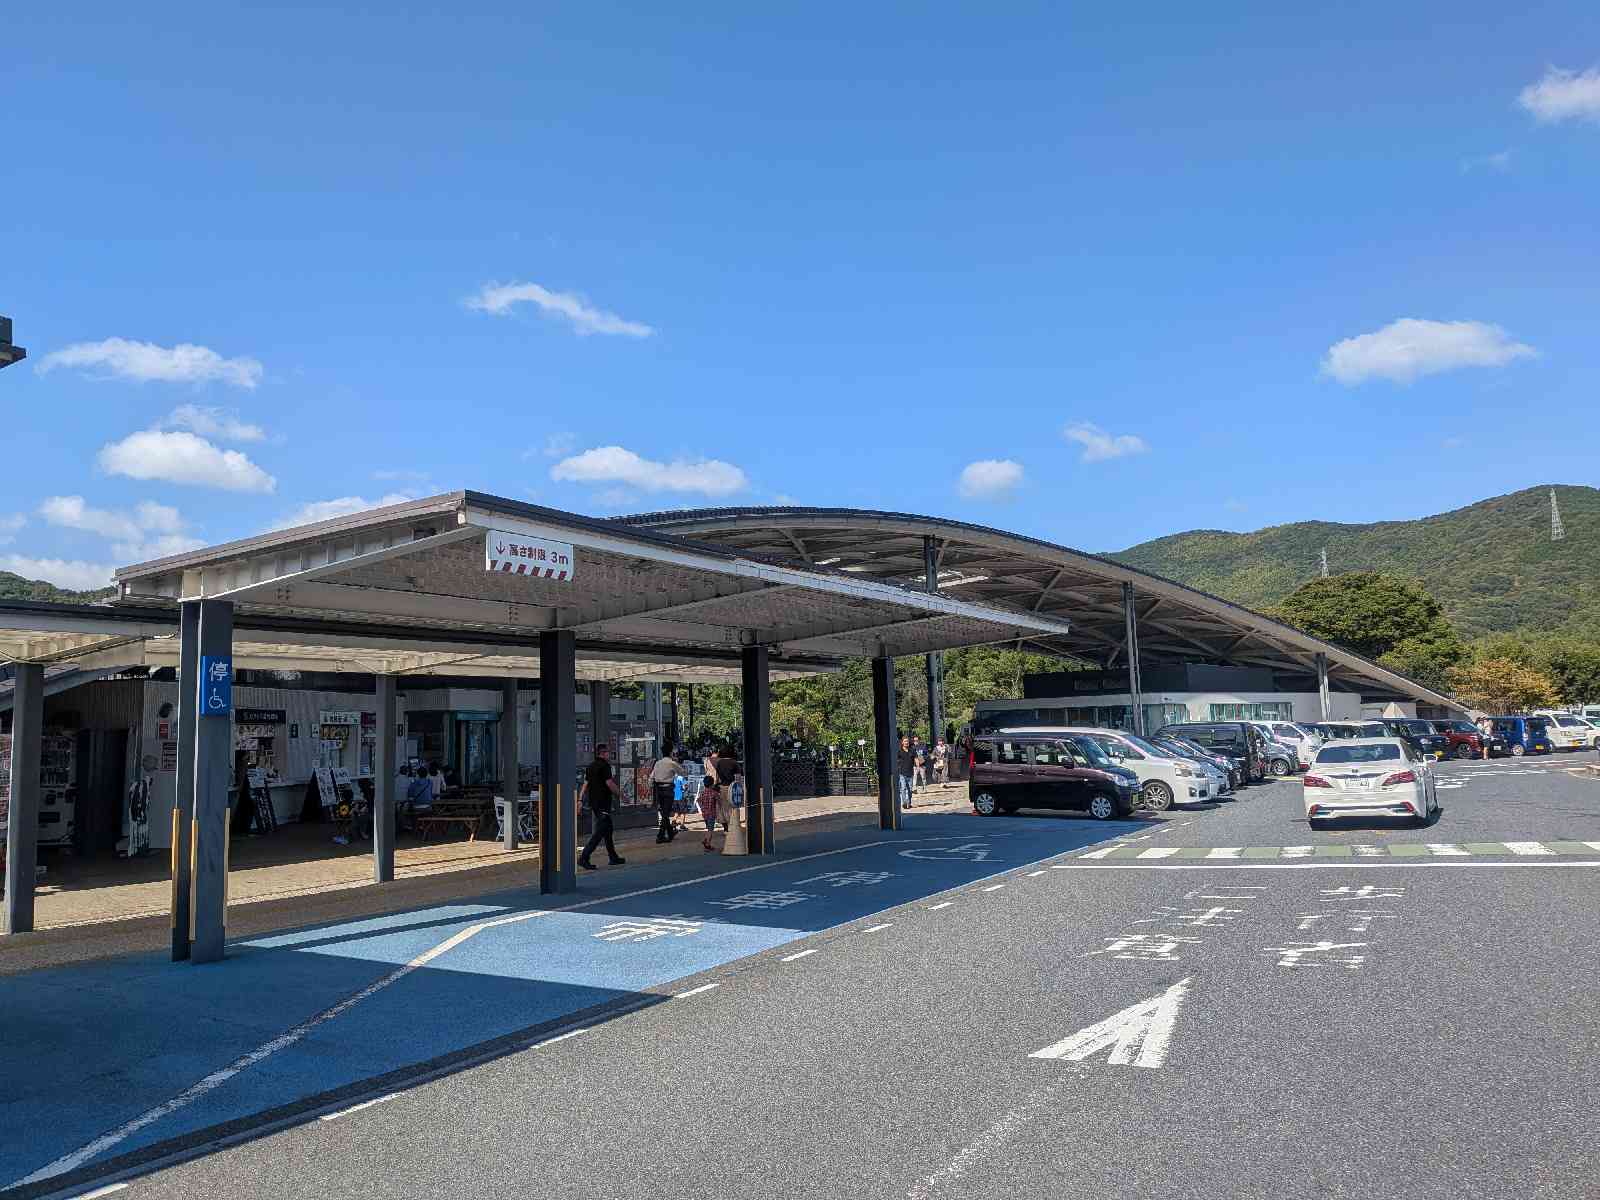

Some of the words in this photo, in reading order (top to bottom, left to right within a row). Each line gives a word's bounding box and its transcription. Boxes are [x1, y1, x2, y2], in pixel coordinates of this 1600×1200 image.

[509, 543, 546, 561] 高さ制限
[550, 551, 569, 565] 3m
[209, 661, 229, 682] 停
